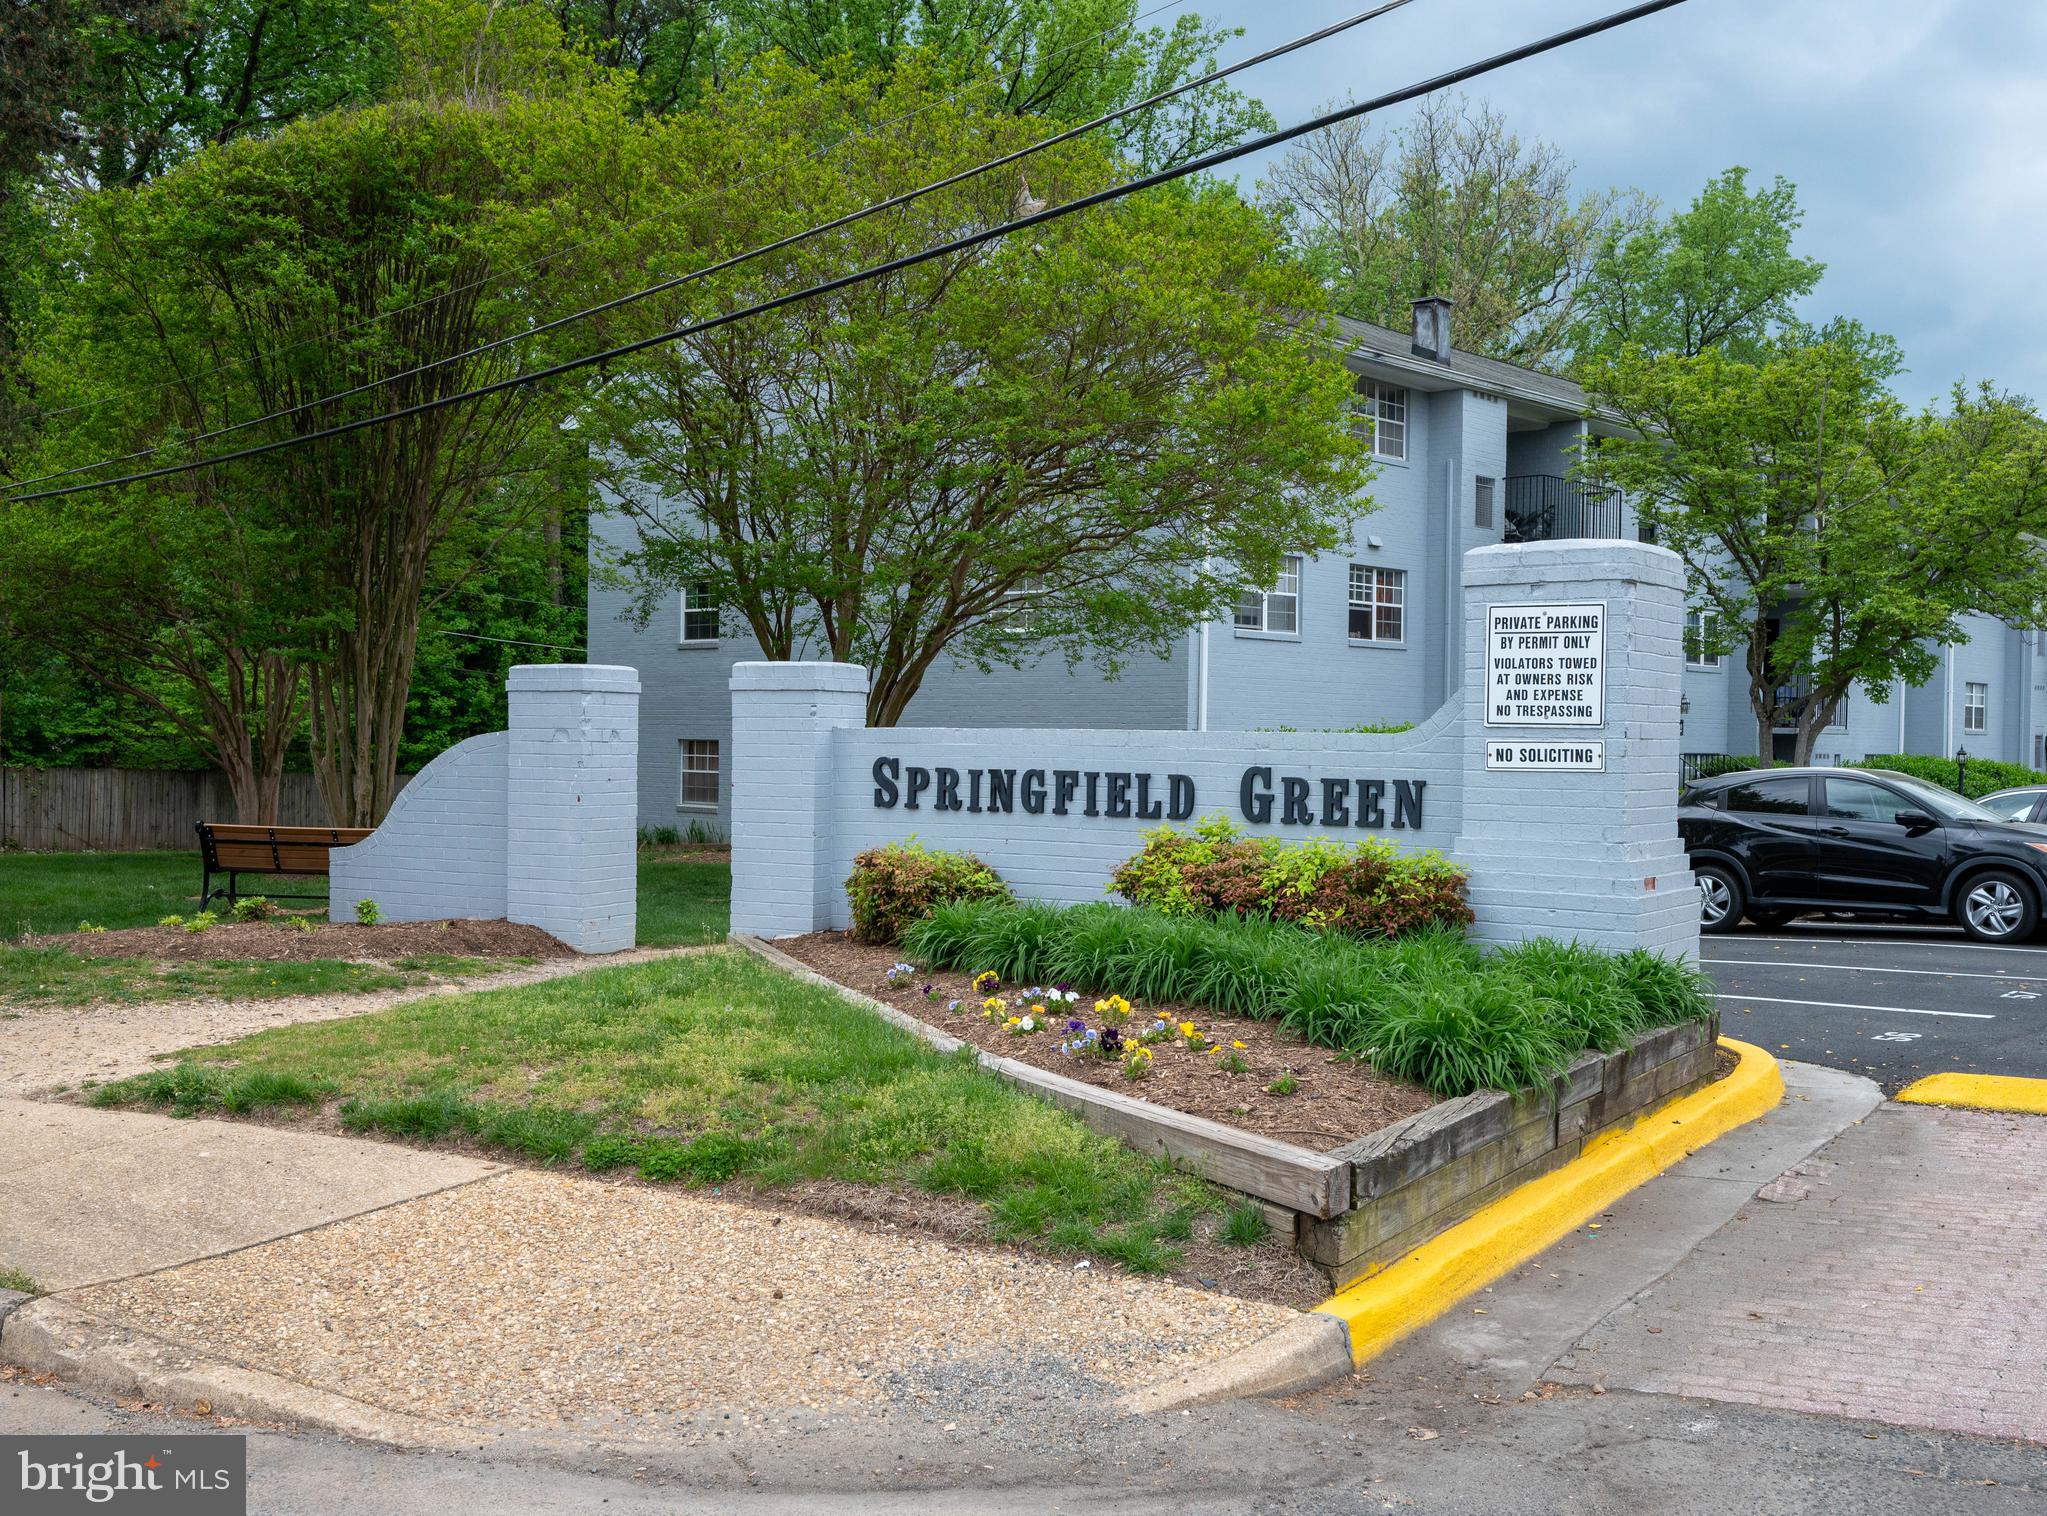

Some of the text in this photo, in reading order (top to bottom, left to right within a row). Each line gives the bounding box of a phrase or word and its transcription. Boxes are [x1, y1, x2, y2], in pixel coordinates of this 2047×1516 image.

[1495, 616, 1598, 629] PRIVATE PARKING
[1501, 636, 1591, 649] BY PERMIT ONLY
[1494, 657, 1597, 669] VIOLATORS TOWED
[1497, 674, 1593, 685] AT OWNERS RISK
[1506, 690, 1583, 701] AND EXPENSE
[1497, 705, 1592, 717] NO TRESPASSING
[1496, 749, 1593, 762] NO SOLICITING
[872, 756, 1427, 829] SPRINGFIELD GREEN
